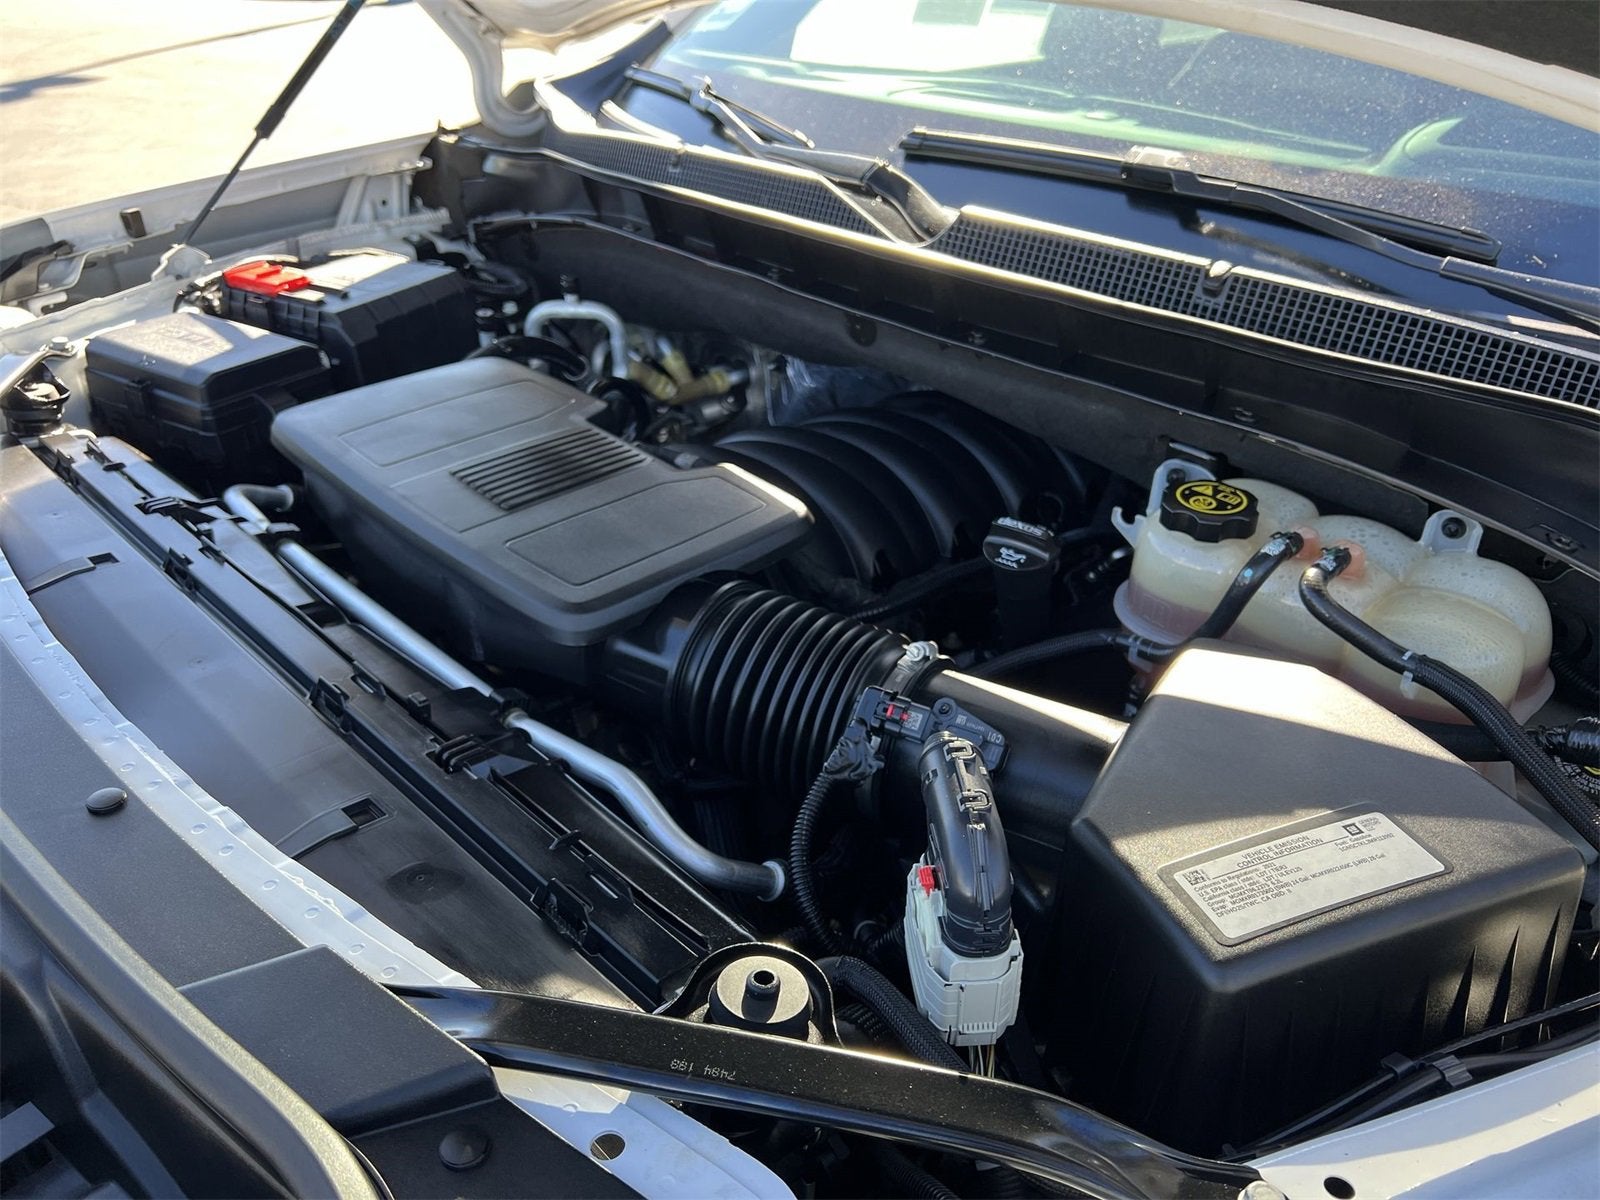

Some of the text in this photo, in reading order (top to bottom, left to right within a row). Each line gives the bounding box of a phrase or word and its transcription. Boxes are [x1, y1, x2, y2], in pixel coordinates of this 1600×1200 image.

[1242, 836, 1310, 859] VEHICLE EMISSION
[1237, 839, 1323, 868] CONTROL INFORMATION
[1194, 881, 1221, 892] Conforms
[1203, 891, 1230, 902] California
[1207, 898, 1228, 907] Group:
